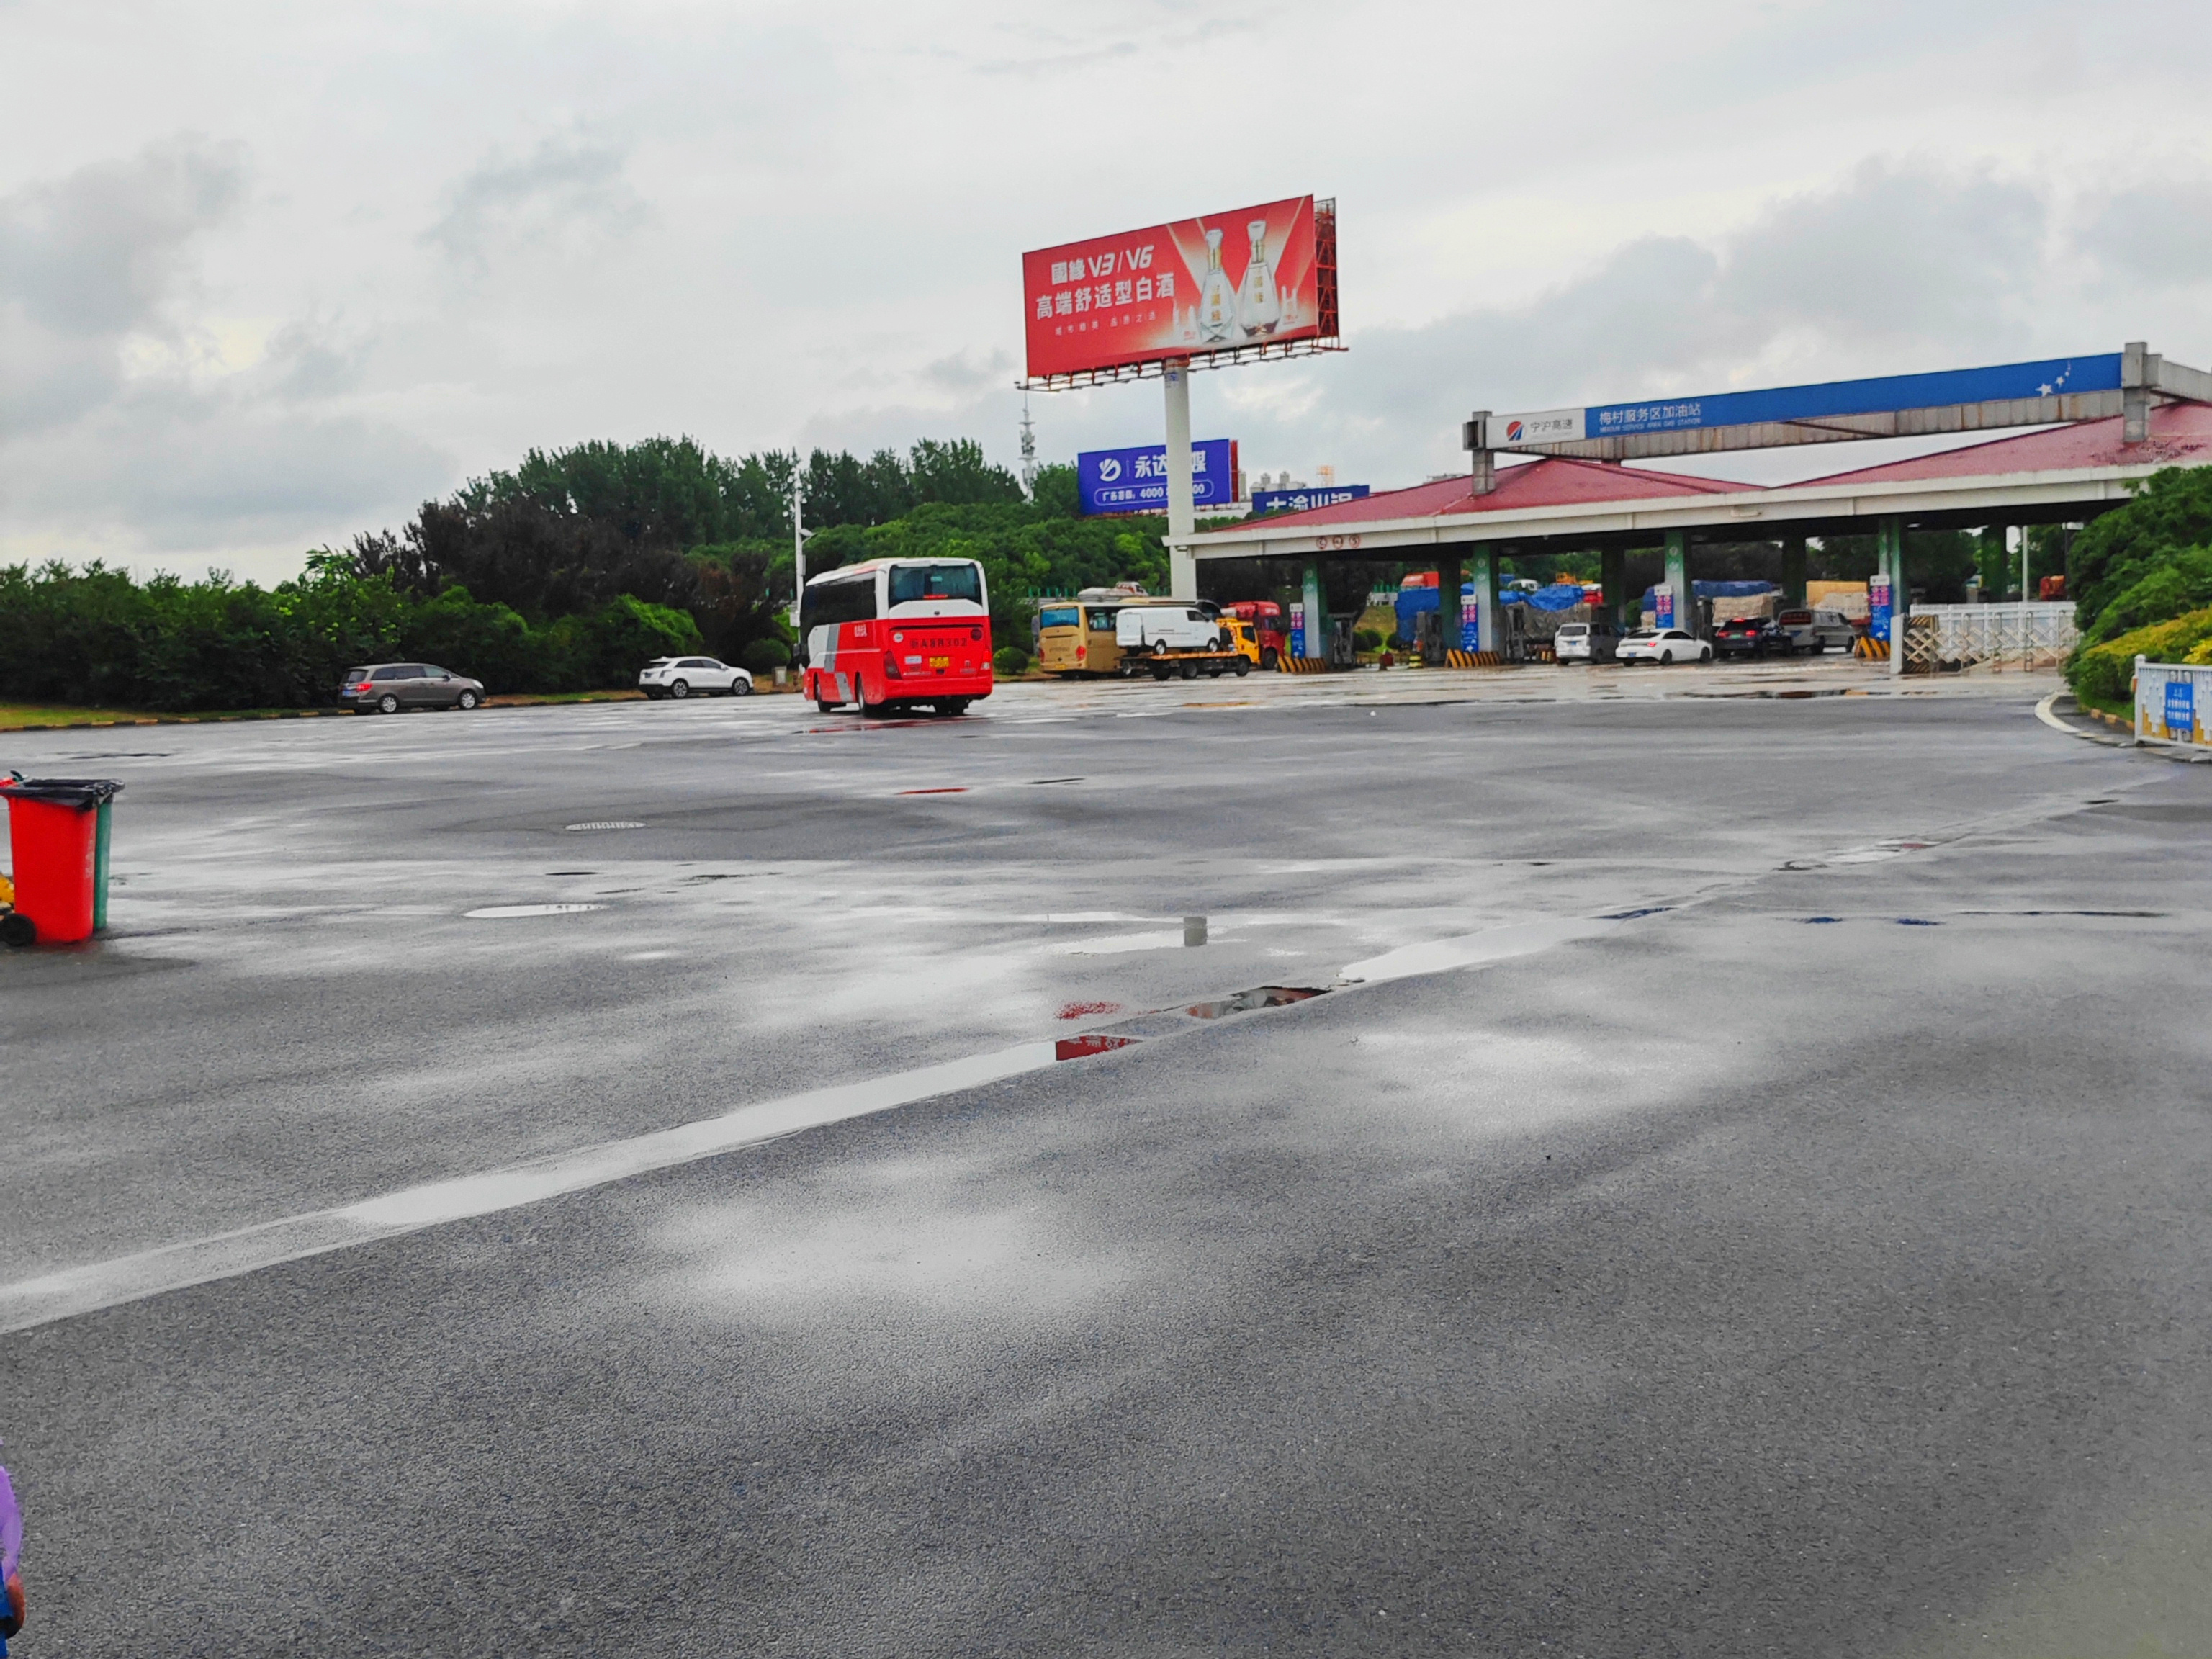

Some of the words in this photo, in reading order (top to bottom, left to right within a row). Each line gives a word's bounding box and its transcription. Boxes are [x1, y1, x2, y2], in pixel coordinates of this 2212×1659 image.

[1036, 271, 1175, 320] 高端舒适型白酒
[1530, 419, 1573, 433] 宁沪高速
[1599, 403, 1701, 426] 梅村服务区加油站
[1135, 450, 1206, 478] 永达媒
[1140, 487, 1164, 499] 4000
